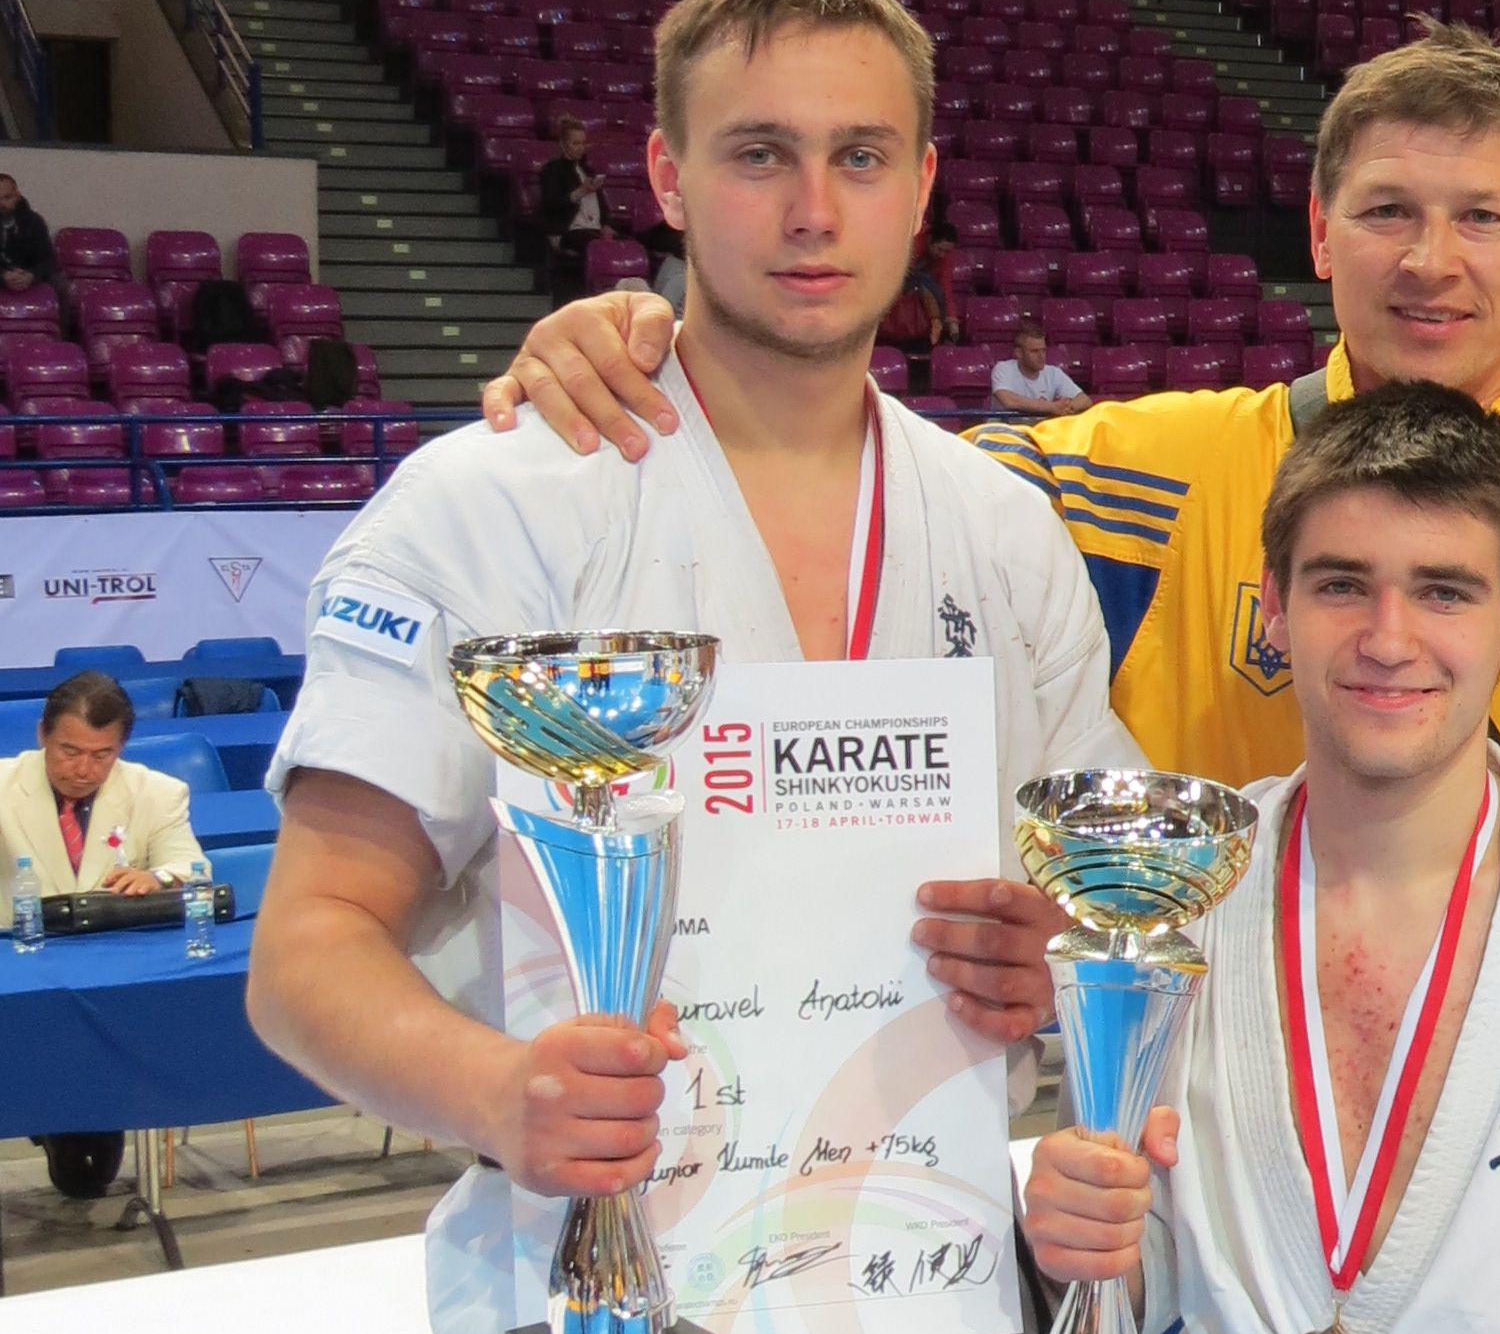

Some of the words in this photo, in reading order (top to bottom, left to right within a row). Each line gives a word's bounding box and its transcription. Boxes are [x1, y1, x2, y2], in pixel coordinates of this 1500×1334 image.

[44, 575, 157, 597] UNI-TROL
[773, 720, 842, 733] EUROPEAN
[845, 716, 949, 730] CHAMPIONSHIPS
[774, 733, 950, 775] KARATE
[703, 722, 754, 815] 2015
[775, 773, 952, 797] SHINKYOKUSHIN
[776, 817, 821, 831] 17-18
[673, 1123, 723, 1138] category
[716, 1140, 790, 1174] Kumite
[799, 1136, 853, 1177] Men
